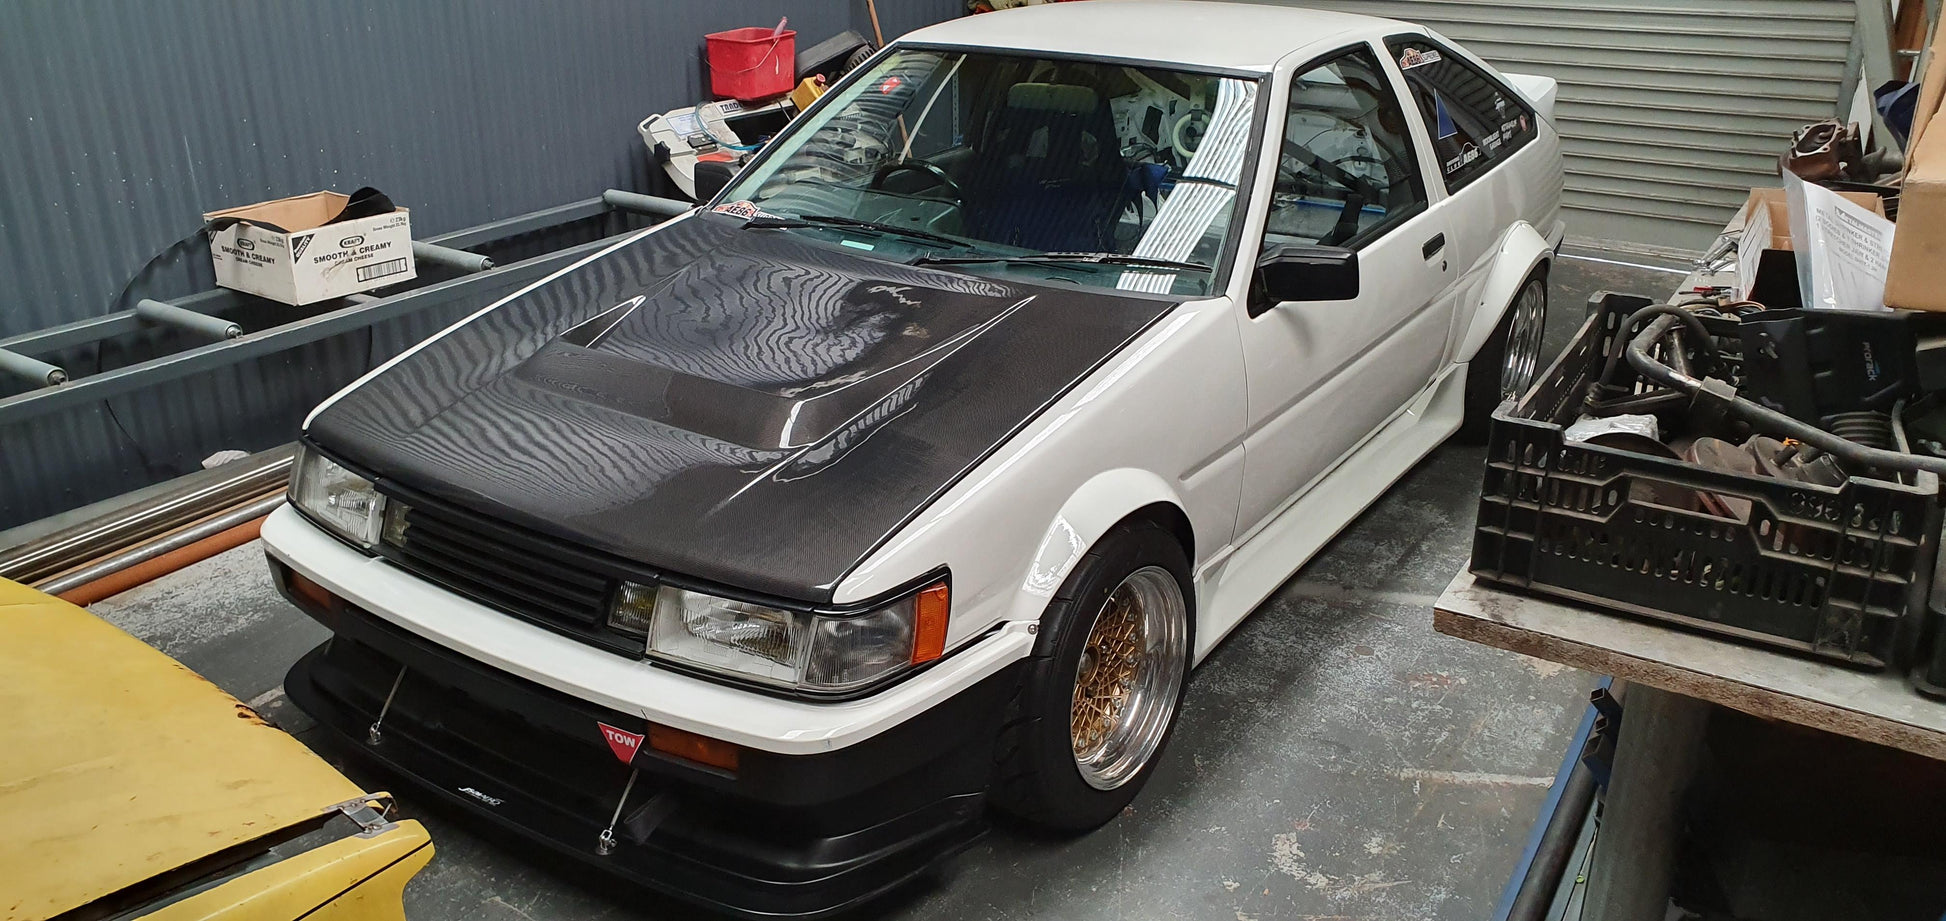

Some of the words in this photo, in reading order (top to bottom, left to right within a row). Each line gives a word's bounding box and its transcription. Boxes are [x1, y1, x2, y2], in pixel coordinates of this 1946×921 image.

[727, 205, 752, 216] AE86
[343, 238, 361, 246] KRAFT
[221, 245, 245, 256] SMOOTH
[251, 253, 275, 265] CREAMY
[313, 250, 349, 264] SMOOTH
[359, 241, 392, 254] CREAMY
[354, 253, 374, 262] CHEESE
[606, 729, 636, 748] TOW
